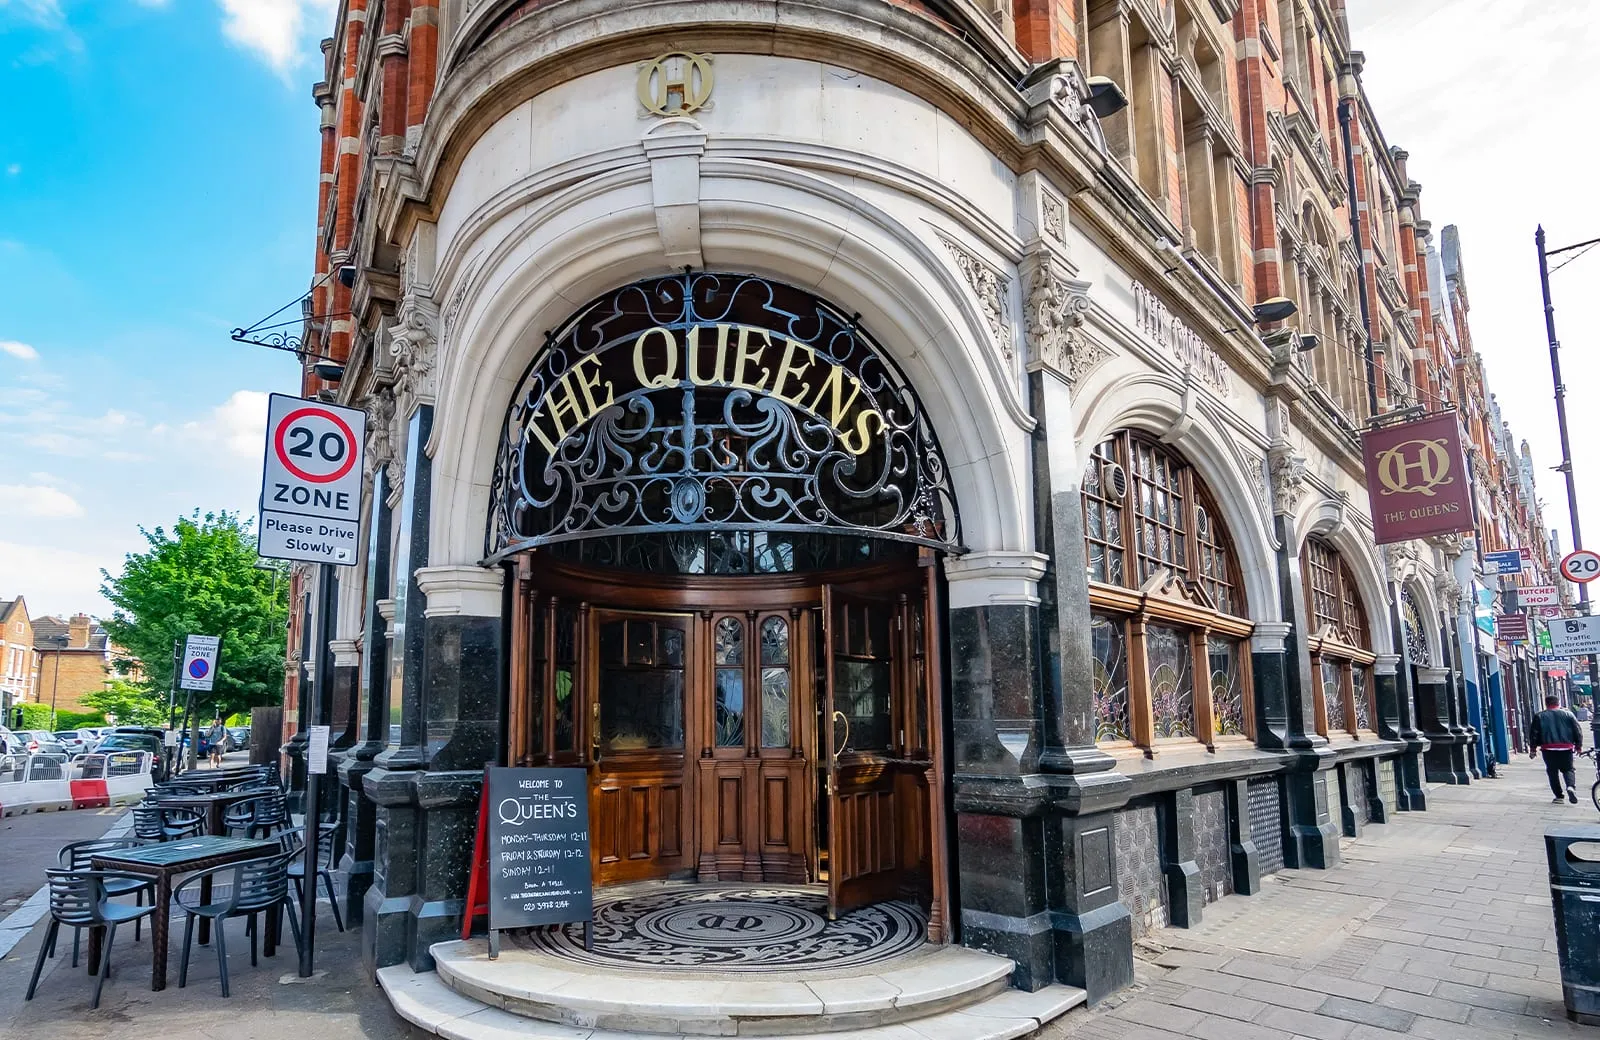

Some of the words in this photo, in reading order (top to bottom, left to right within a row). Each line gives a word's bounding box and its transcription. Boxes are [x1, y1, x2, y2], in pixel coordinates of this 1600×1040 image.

[523, 353, 615, 457] THE
[631, 322, 891, 456] QUEENS
[289, 426, 345, 462] 20
[273, 483, 350, 511] ZONE
[1383, 511, 1407, 524] THE
[1409, 502, 1459, 519] QUEENS
[266, 518, 313, 535] Please
[319, 525, 354, 539] Drive
[285, 538, 334, 555] Slowly
[1568, 558, 1599, 573] 20
[1518, 588, 1556, 596] BUTCHER
[1565, 634, 1591, 642] Traffic
[1564, 646, 1597, 654] cameras
[518, 779, 549, 789] WELCOME
[554, 779, 563, 788] TO
[499, 798, 577, 825] QUEEN'S
[501, 850, 525, 861] FRIDAY
[526, 850, 533, 861] &
[564, 849, 584, 859] 12-12
[502, 865, 531, 878] SUNDAY
